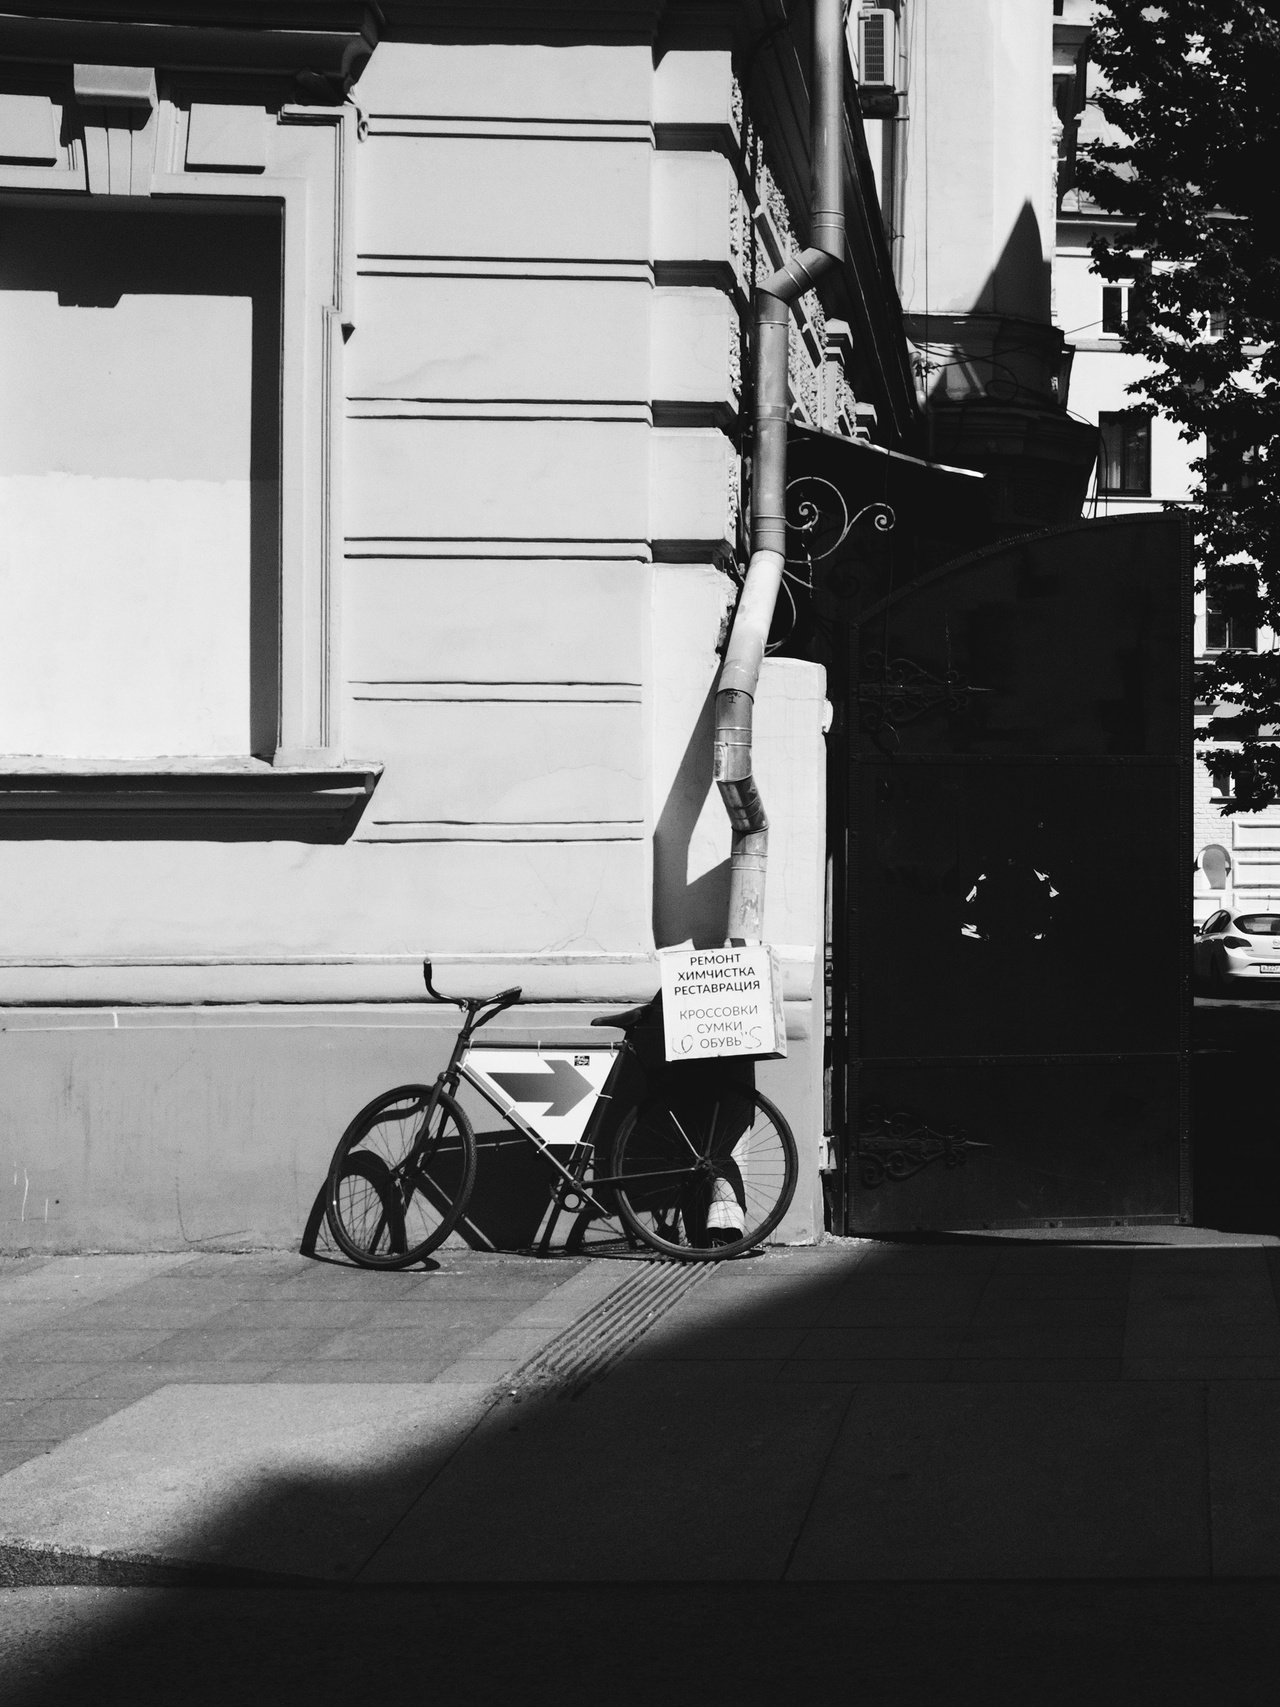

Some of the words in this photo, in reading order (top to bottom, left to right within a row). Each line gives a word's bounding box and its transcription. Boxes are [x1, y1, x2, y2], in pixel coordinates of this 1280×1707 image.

[690, 953, 741, 966] РЕМОНТ
[677, 967, 755, 981] ХИМЧИСТКА
[674, 980, 760, 996] РЕСТАВРАЦИЯ
[679, 1005, 758, 1020] КРОССОВКИ
[696, 1021, 743, 1034] СУМКИ
[700, 1036, 742, 1049] ОБУВЬ
